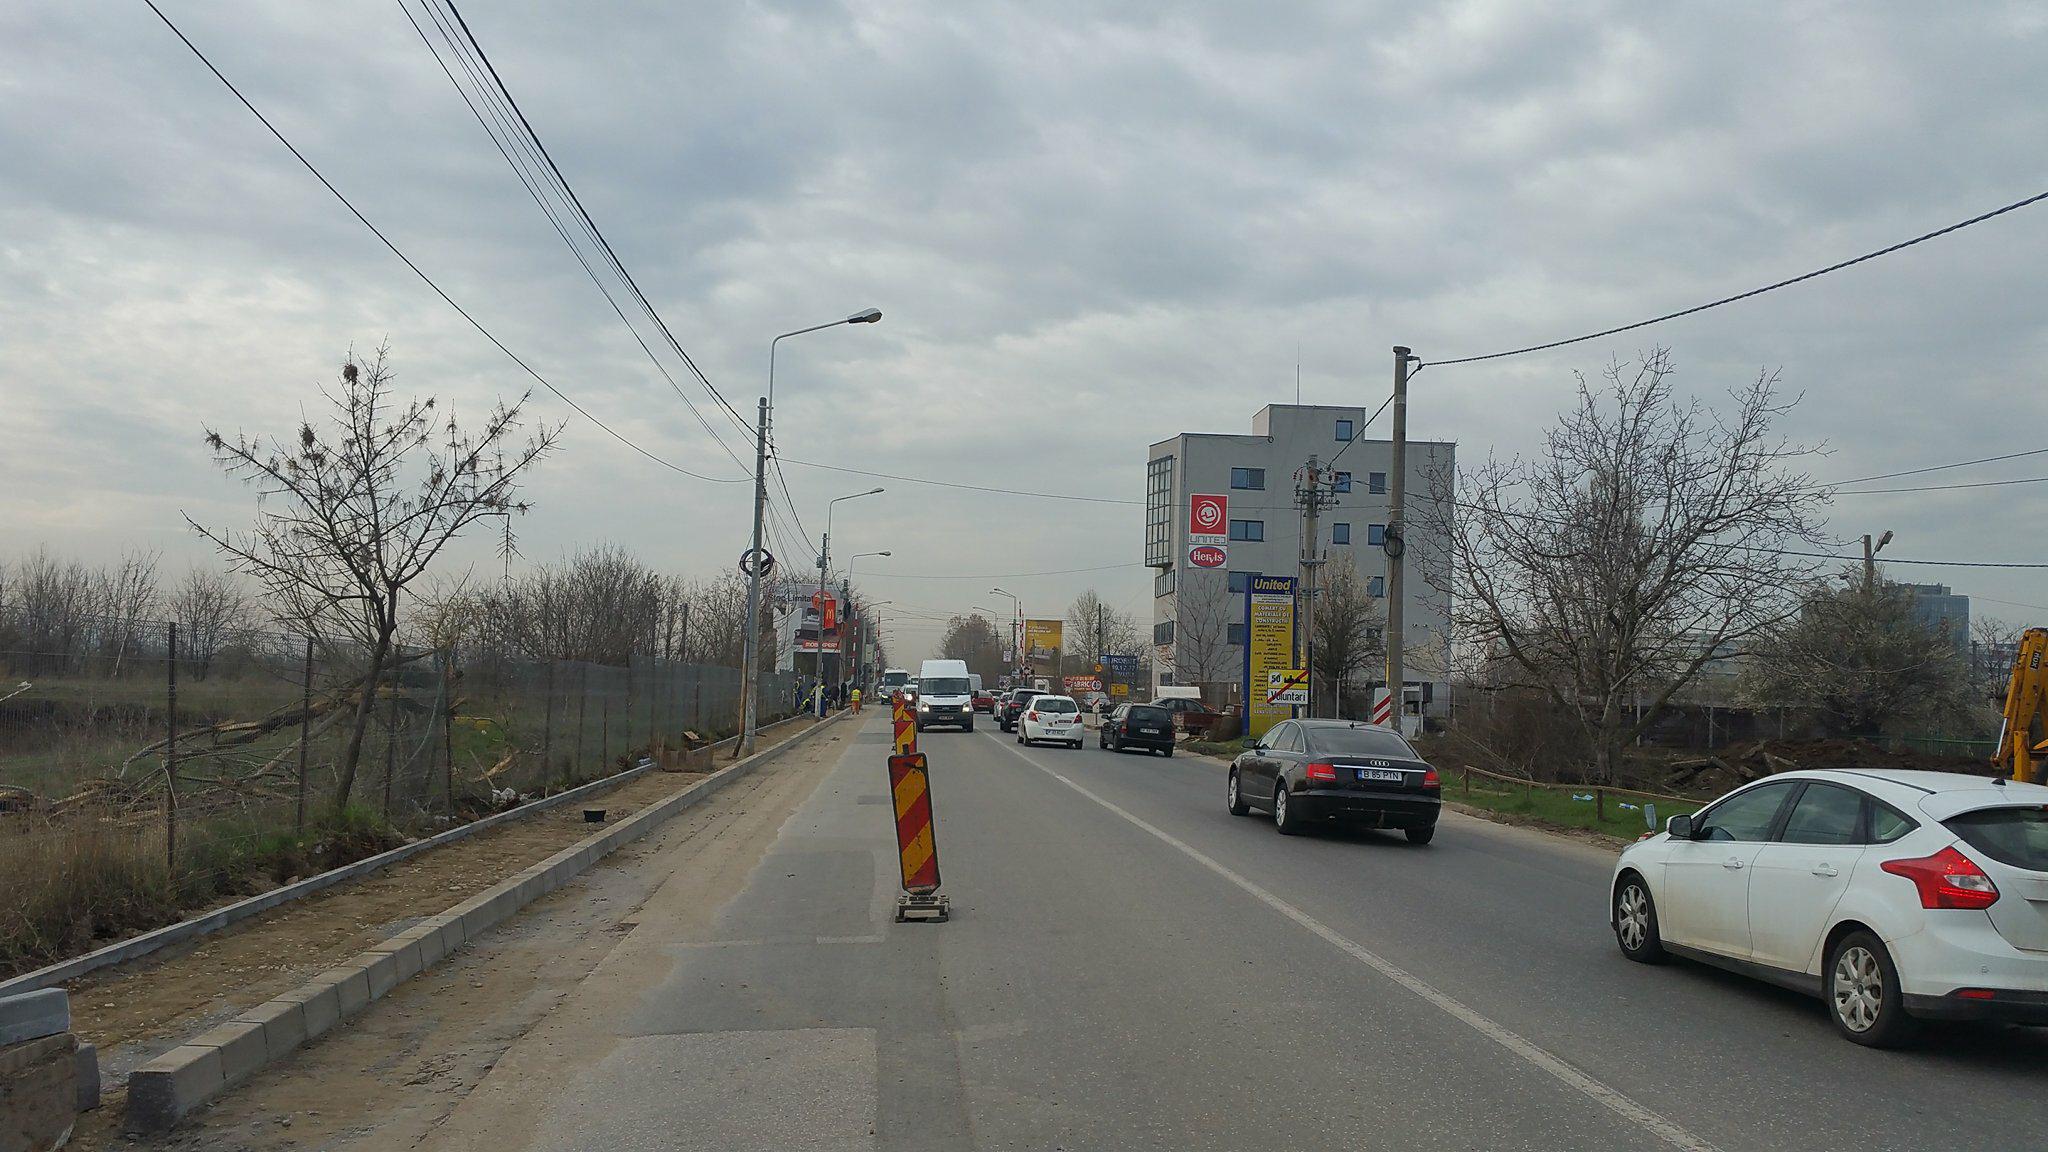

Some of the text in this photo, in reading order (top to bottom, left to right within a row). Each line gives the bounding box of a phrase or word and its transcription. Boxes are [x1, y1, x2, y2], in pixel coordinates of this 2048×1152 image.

[1193, 550, 1223, 563] Hervis
[1254, 578, 1291, 590] United
[1271, 674, 1281, 683] 50
[1270, 690, 1306, 701] Voluntari
[1364, 770, 1398, 780] B 85 PTN
